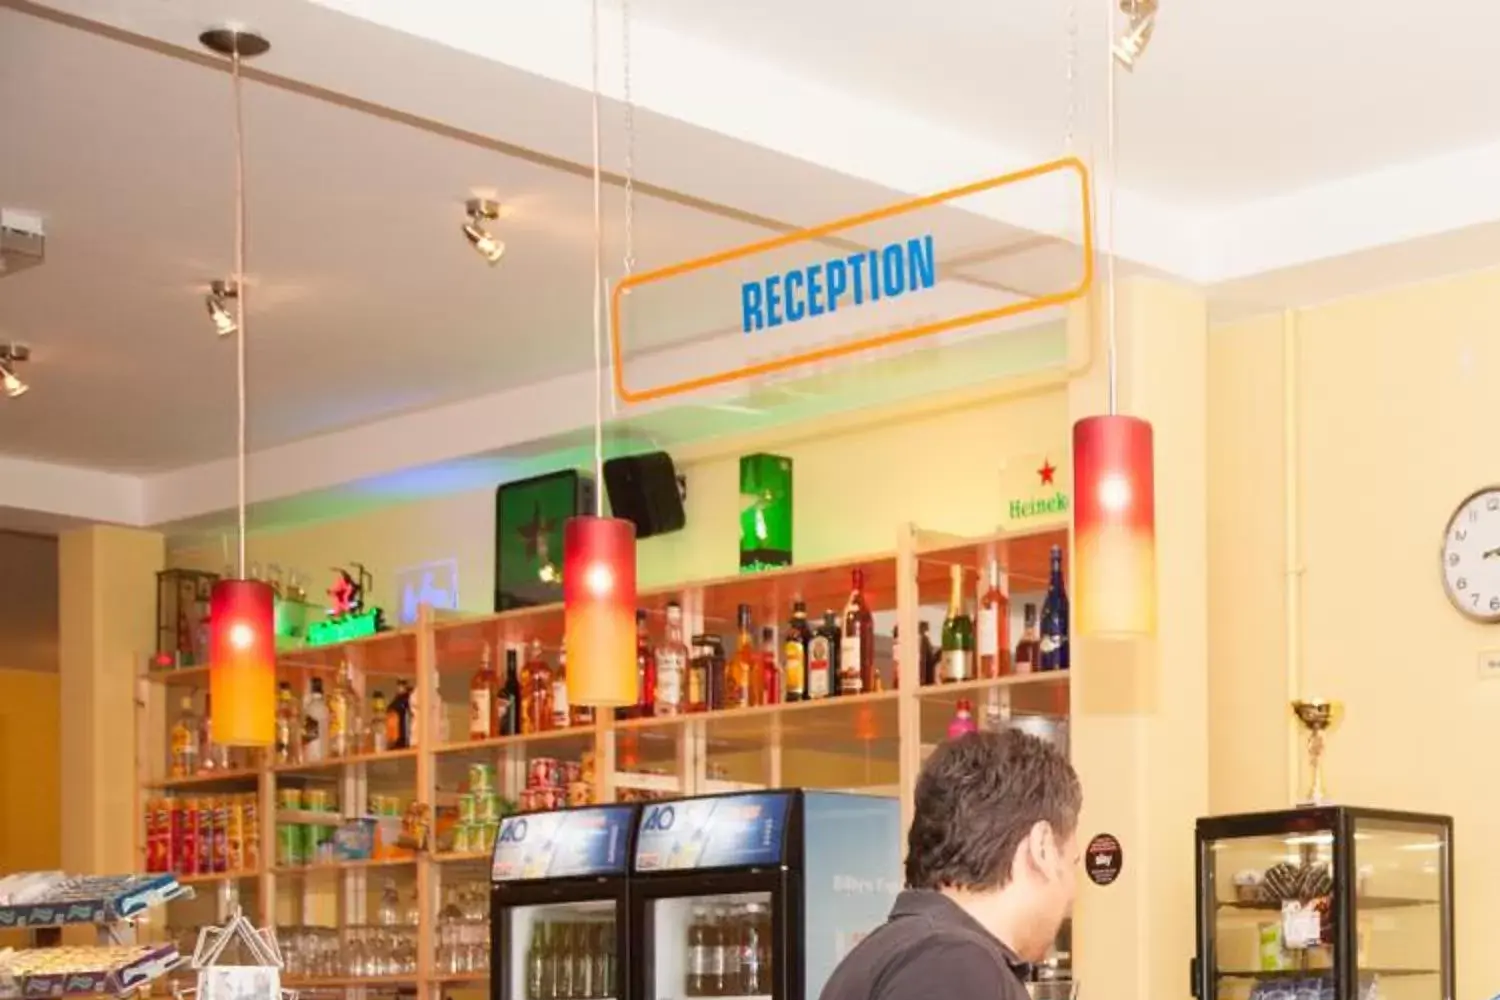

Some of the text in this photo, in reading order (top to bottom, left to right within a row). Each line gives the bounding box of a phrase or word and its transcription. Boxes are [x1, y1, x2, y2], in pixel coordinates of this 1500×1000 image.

[741, 234, 935, 333] RECEPTION
[1471, 592, 1480, 607] 7
[1489, 595, 1500, 611] 6
